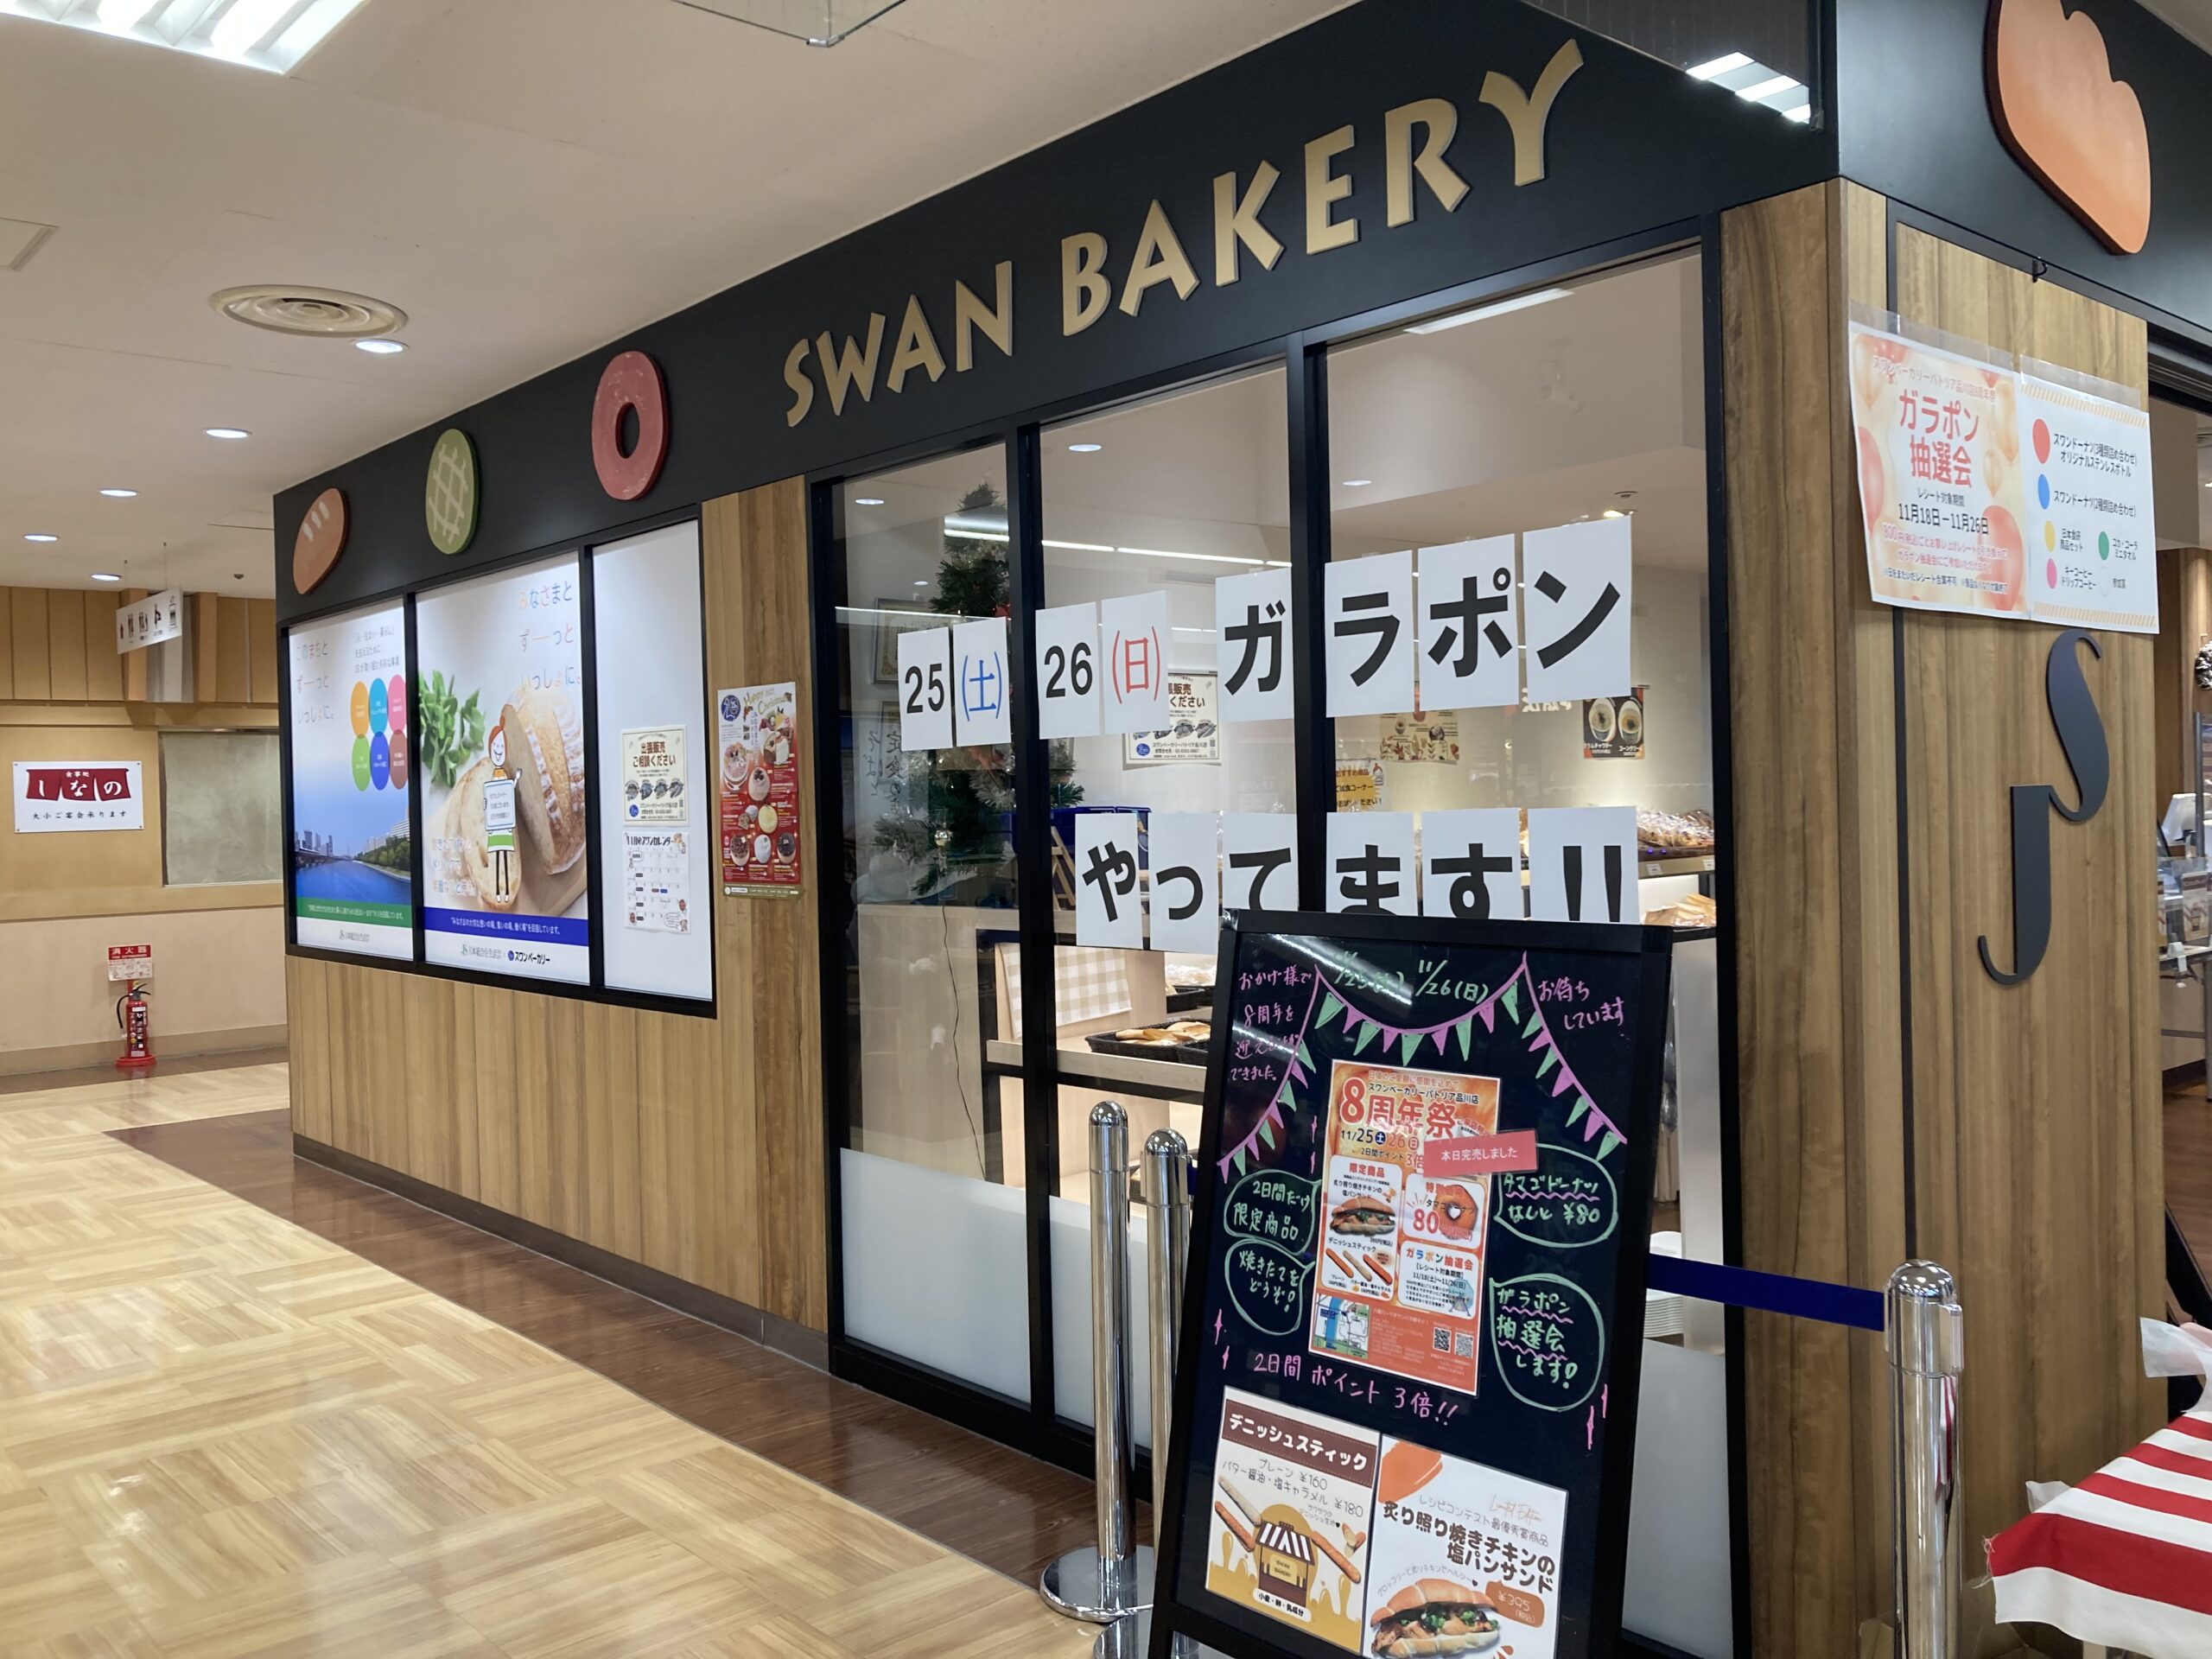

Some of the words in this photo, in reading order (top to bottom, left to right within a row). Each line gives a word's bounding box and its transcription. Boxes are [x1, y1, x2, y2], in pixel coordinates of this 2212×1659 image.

[783, 260, 1014, 429] SWAN
[1060, 36, 1585, 336] BAKERY
[1899, 389, 1980, 442] ガラポン
[1910, 434, 1972, 488] 抽選会
[1224, 566, 1622, 696] ガラポン
[1170, 696, 1206, 708] ください
[632, 754, 677, 768] ご相談ください
[640, 741, 666, 754] 出張販売
[38, 779, 123, 798] しなの
[33, 810, 128, 820] 大小ご宴会承ります
[111, 945, 148, 955] 消火器
[514, 951, 551, 965] スワンベーカリー
[1238, 963, 1313, 991] おかげ様で
[1414, 959, 1489, 1005] 11/26(日)
[1537, 976, 1590, 1002] お待ち
[1243, 1001, 1295, 1029] 8周年を
[1564, 996, 1625, 1031] しています
[1230, 1065, 1278, 1081] できました。
[1340, 1077, 1458, 1139] 8周年祭
[1368, 1083, 1480, 1105] スワンベーカリーパトリア品川店
[1440, 1146, 1519, 1162] 本日完売しました
[1349, 1162, 1385, 1179] 限定商品
[1252, 1180, 1311, 1212] 2日間だけ
[1233, 1202, 1299, 1241] 限定商品
[1507, 1205, 1554, 1224] なんと
[1562, 1202, 1601, 1225] ¥80
[1328, 1236, 1376, 1253] デニッシュスティック
[1238, 1249, 1300, 1287] 焼きたてを
[1497, 1287, 1571, 1314] ガラポン
[1496, 1313, 1566, 1353] 抽選会
[1253, 1353, 1301, 1382] 2日間
[1312, 1365, 1381, 1404] ポイント
[1229, 1412, 1368, 1471] デニッシュスティック
[1222, 1460, 1328, 1505] バター醤油・塩キャラメル
[1334, 1497, 1363, 1518] ¥180
[1259, 1458, 1294, 1478] プレーン
[1300, 1471, 1328, 1491] ¥160
[1419, 1494, 1549, 1548] レシピコンテスト最優秀賞商品
[1382, 1500, 1556, 1577] 炙り照り焼きチキンの
[1446, 1541, 1554, 1594] 塩パンサンド
[1497, 1591, 1532, 1612] ¥395
